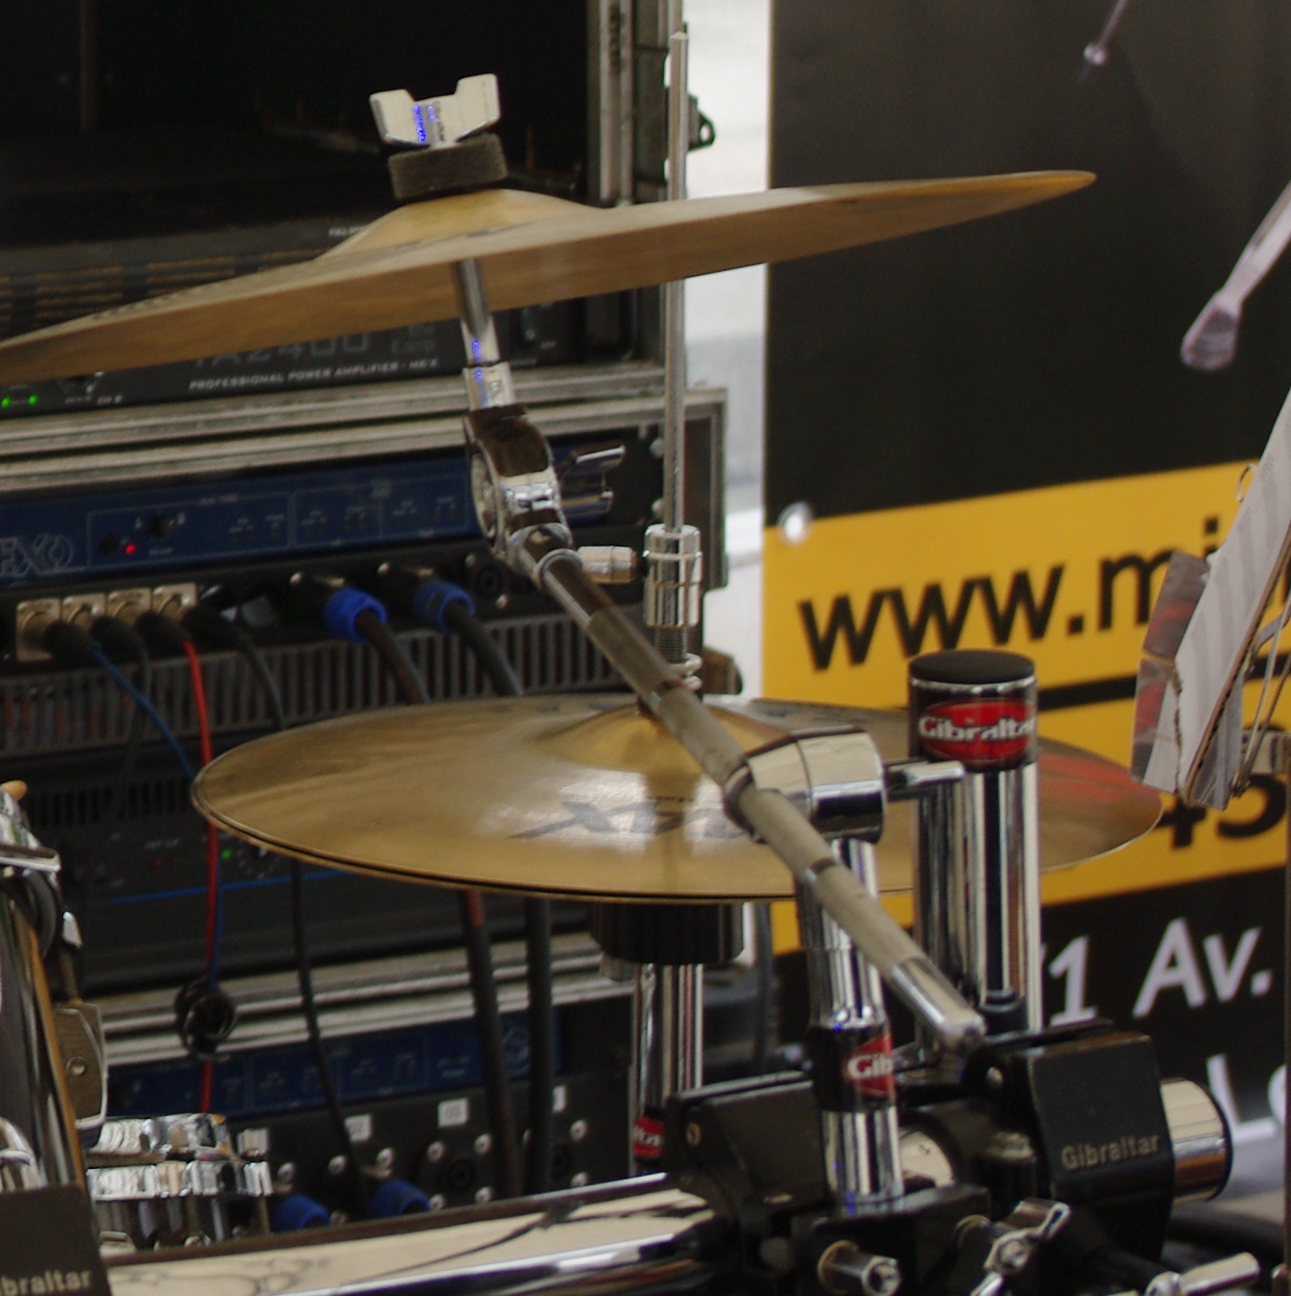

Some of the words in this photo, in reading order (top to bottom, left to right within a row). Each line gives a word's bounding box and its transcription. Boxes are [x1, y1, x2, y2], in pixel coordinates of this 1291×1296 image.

[189, 373, 285, 391] PROFESSIONAL
[287, 367, 331, 382] POWER
[334, 362, 397, 379] AMPLIFIER
[799, 517, 1221, 671] www.m
[1039, 934, 1098, 1026] 1
[1132, 917, 1273, 1019] Av.
[1060, 1134, 1160, 1171] Gibraltar
